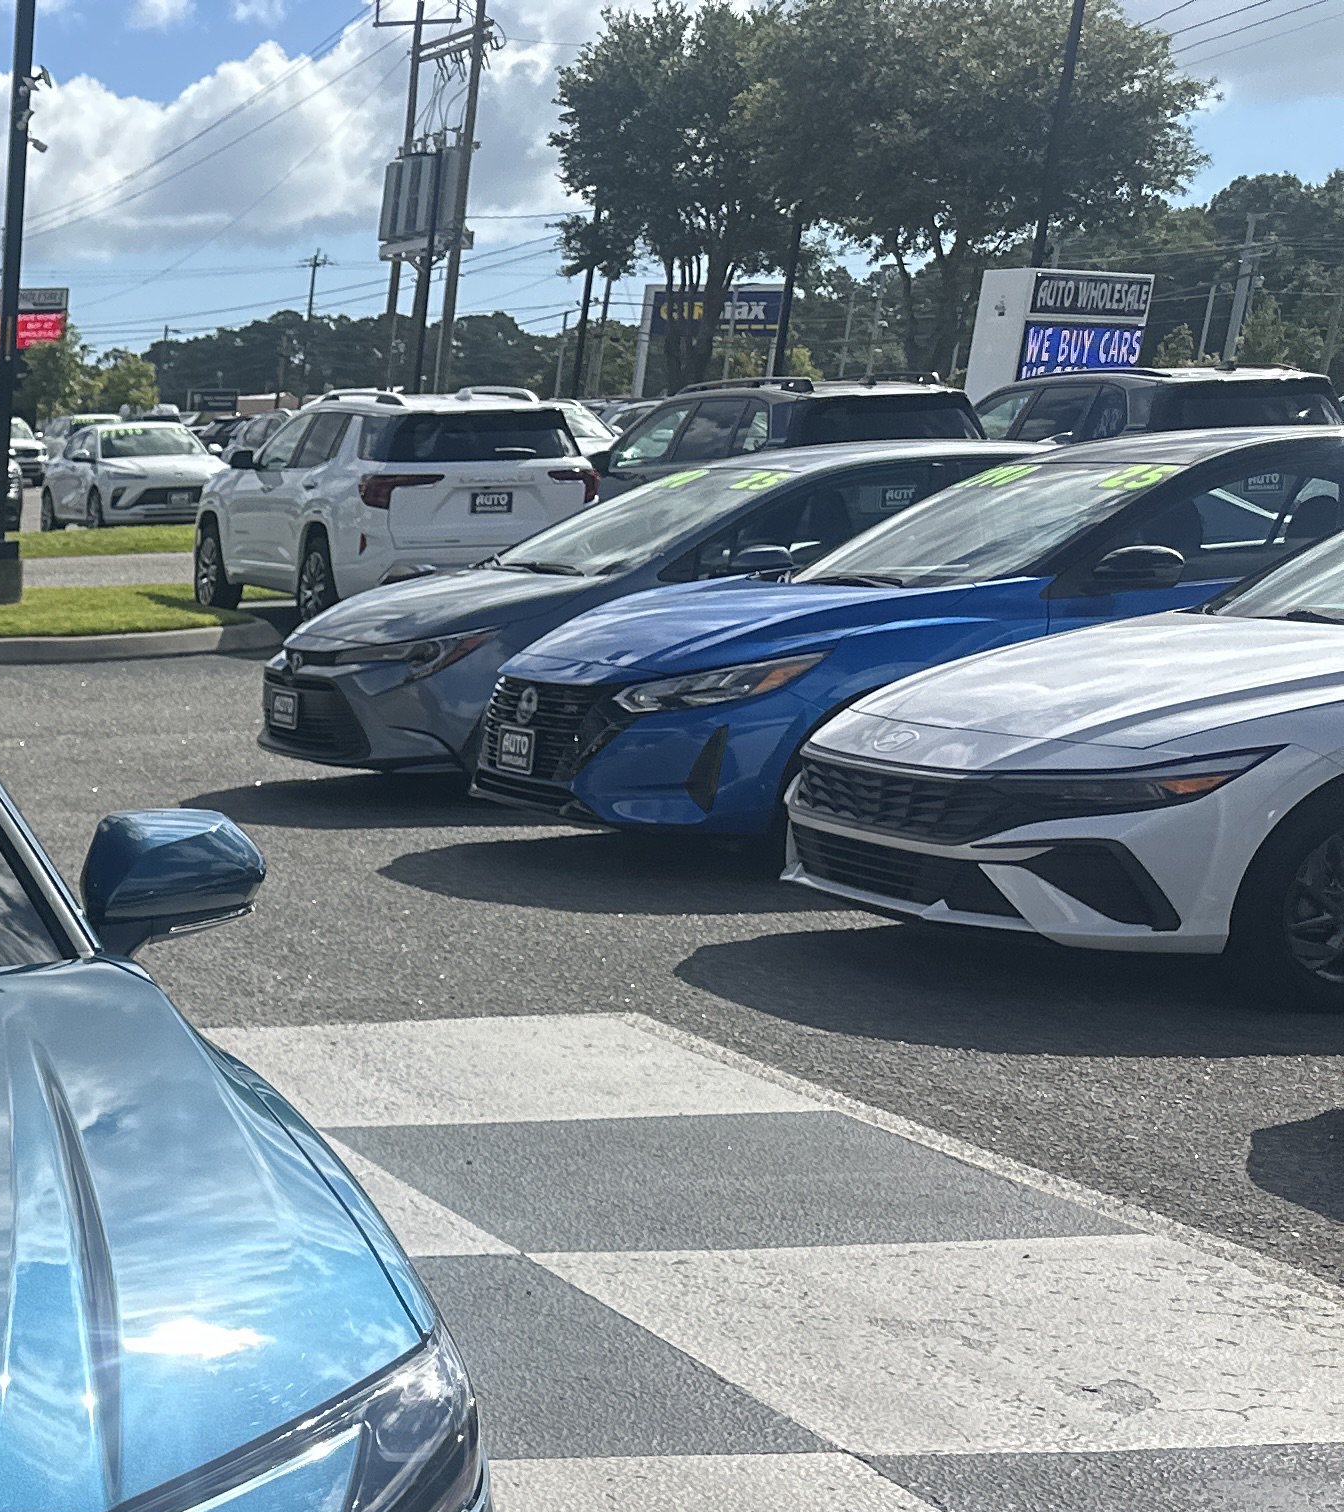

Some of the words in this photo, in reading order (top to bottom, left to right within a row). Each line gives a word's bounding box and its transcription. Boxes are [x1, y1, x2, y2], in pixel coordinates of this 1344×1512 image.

[1037, 280, 1074, 308] AUTO
[1077, 281, 1149, 311] WHOLESALE
[1026, 327, 1053, 363] WE
[1057, 329, 1094, 363] BUY
[1098, 329, 1142, 364] CARS
[729, 471, 792, 490] 25
[1097, 464, 1180, 490] 25
[475, 494, 508, 506] AUTO
[502, 733, 529, 755] AUTO
